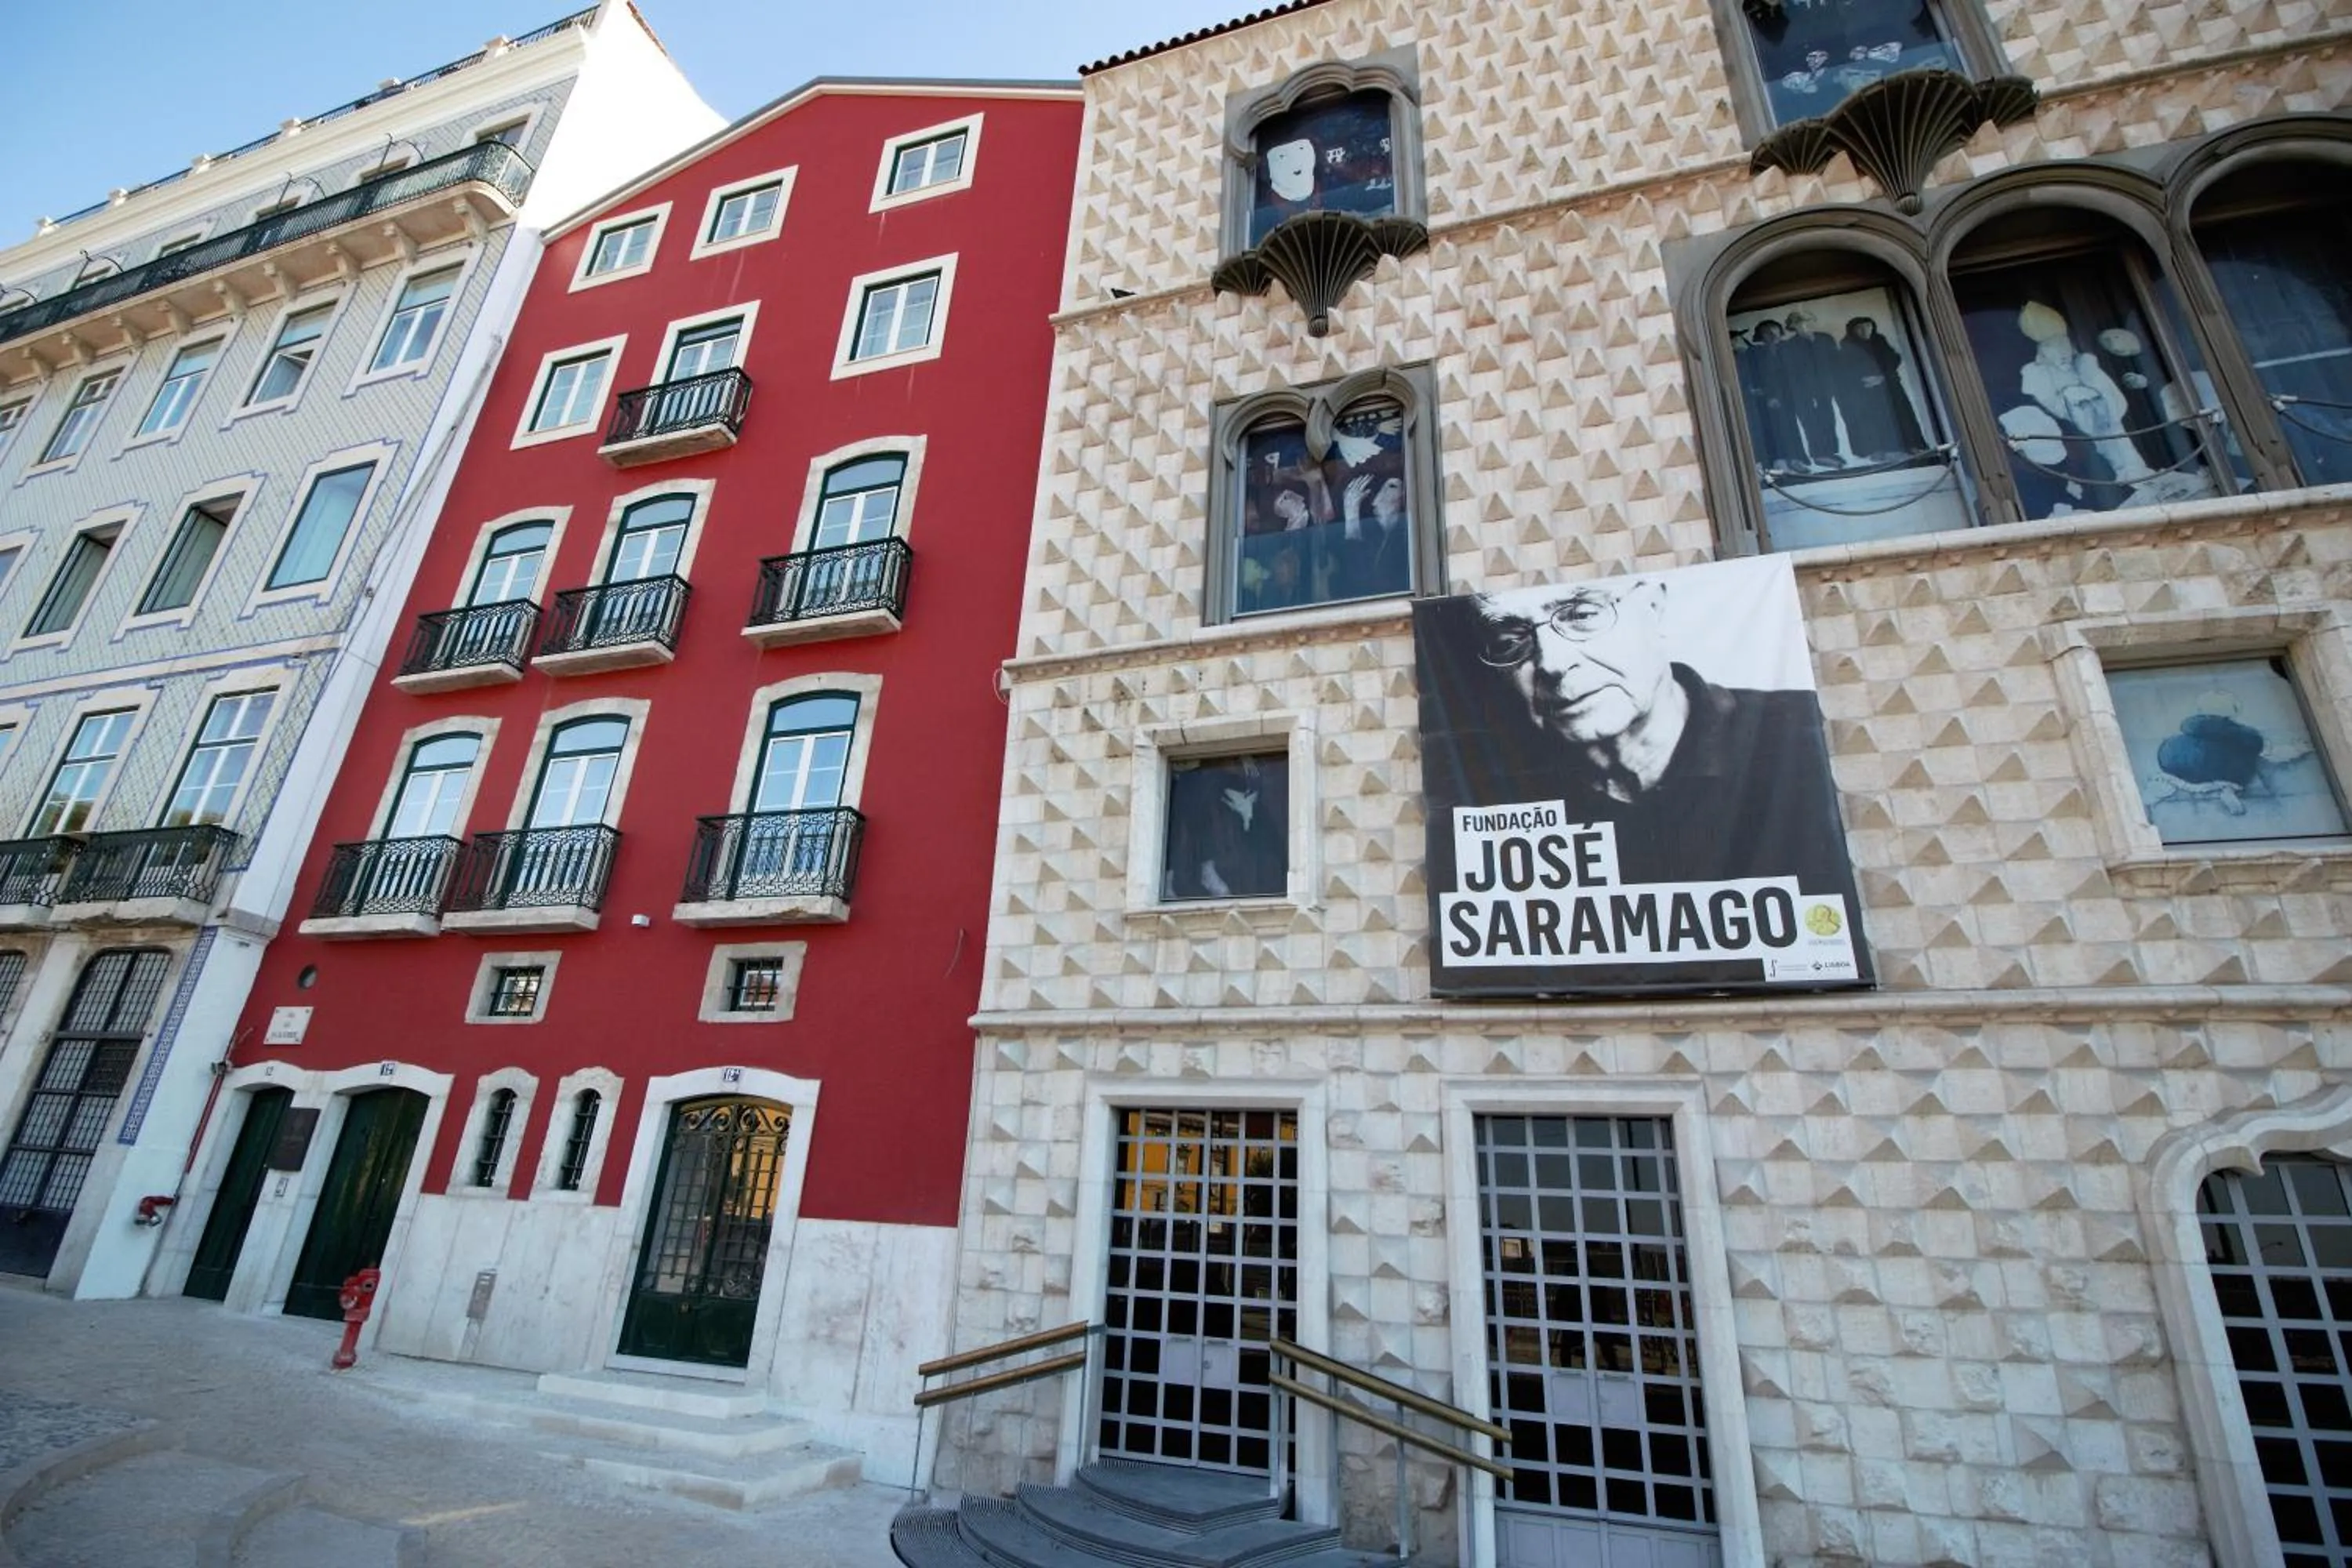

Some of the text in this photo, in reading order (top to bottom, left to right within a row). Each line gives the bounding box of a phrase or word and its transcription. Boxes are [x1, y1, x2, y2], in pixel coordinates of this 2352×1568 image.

[1462, 807, 1558, 833] FUNDAÇÃO
[1465, 822, 1608, 893] JOSÉ
[1449, 887, 1798, 957] SARAMAGO
